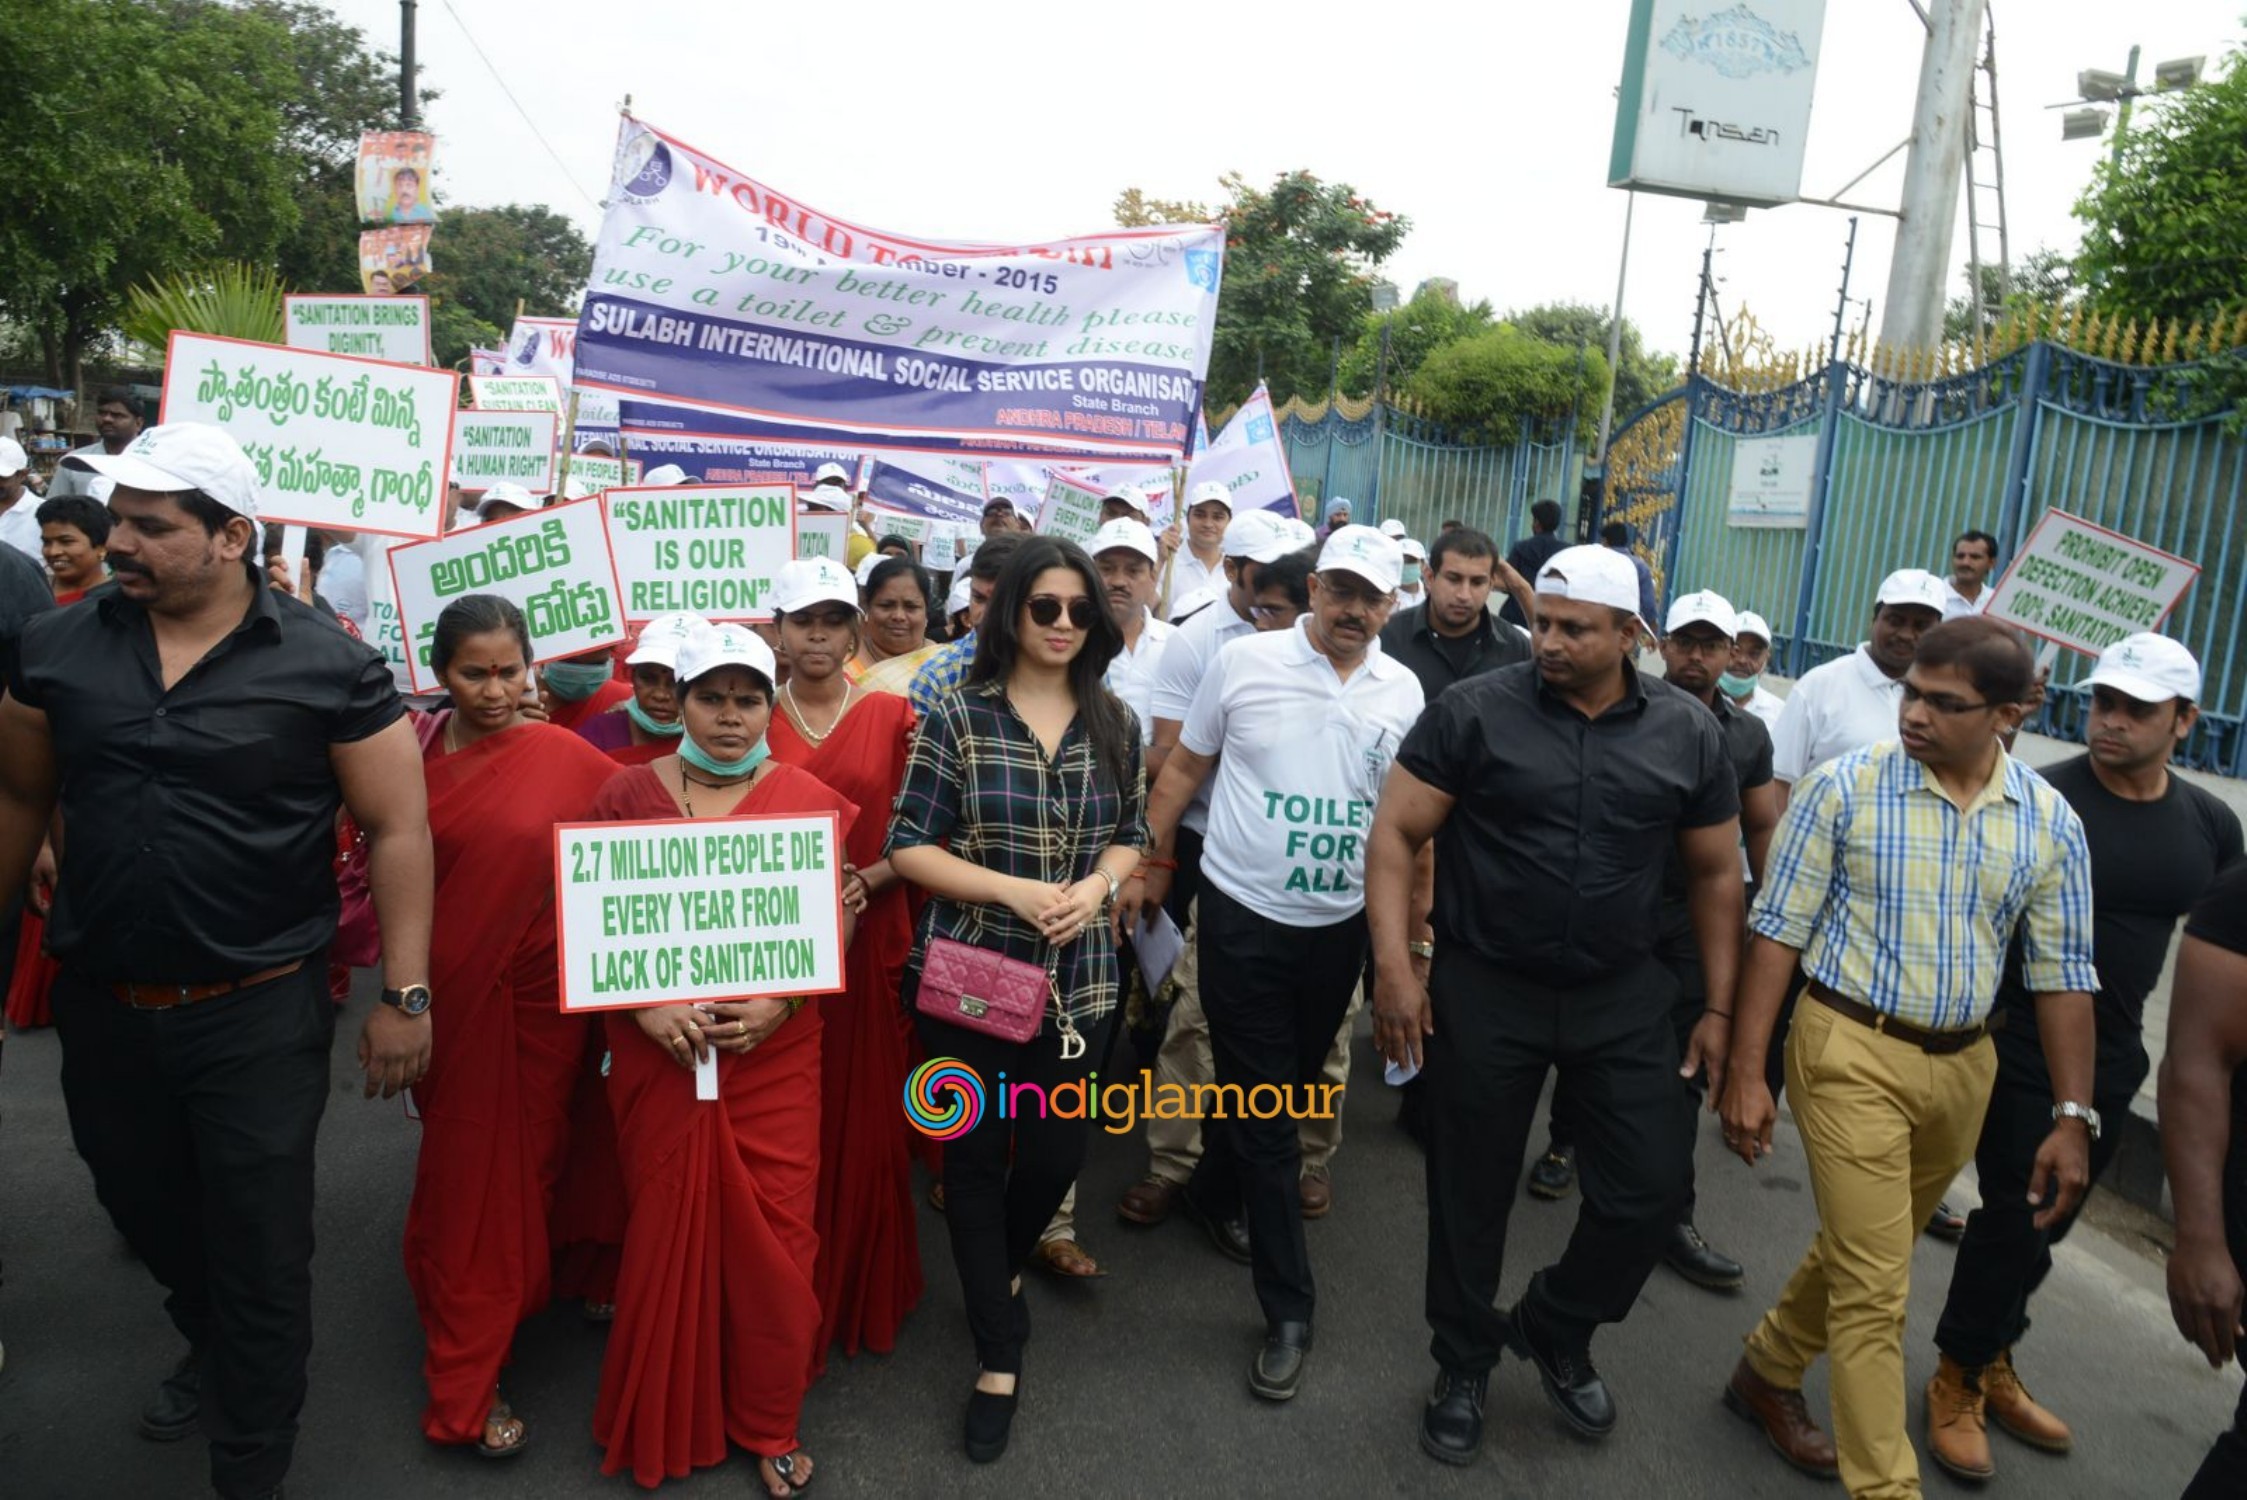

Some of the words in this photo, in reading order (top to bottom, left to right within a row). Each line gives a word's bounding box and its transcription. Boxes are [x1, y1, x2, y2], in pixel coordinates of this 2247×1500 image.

[692, 162, 855, 260] WORLD
[620, 225, 706, 259] For
[709, 250, 820, 286] your
[836, 269, 947, 308] better
[960, 290, 1072, 327] health
[1081, 307, 1198, 334] please
[995, 266, 1059, 295] 2015
[373, 304, 420, 326] BRINGS
[602, 266, 674, 295] use
[691, 285, 721, 307] a
[736, 293, 848, 328] toilet
[863, 313, 912, 337] &
[914, 323, 1049, 358] prevent
[1066, 336, 1194, 362] disease
[589, 303, 695, 347] SULABH
[699, 322, 888, 382] INTERNATIONAL
[893, 356, 972, 393] SOCIAL
[976, 368, 1074, 392] SERVICE
[313, 374, 370, 424] కంటే
[371, 386, 421, 448] మిన్న
[995, 408, 1062, 428] ANDHRA
[1064, 411, 1133, 438] PRADESH
[1072, 394, 1109, 411] State
[1111, 398, 1160, 417] Branch
[457, 455, 464, 475] A
[467, 455, 507, 476] HUMAN
[748, 457, 771, 469] State
[773, 459, 806, 470] Branch
[370, 460, 434, 515] గాంధీ
[613, 496, 786, 531] “SANITATION
[655, 540, 680, 570] IS
[688, 539, 746, 570] OUR
[2054, 529, 2130, 574] PROHIBIT
[2121, 556, 2169, 591] OPEN
[631, 578, 771, 611] RELIGION”
[2007, 588, 2046, 623] 100%
[2016, 554, 2102, 605] DEFECTION
[2093, 585, 2163, 627] ACHIEVE
[379, 624, 403, 642] FO
[380, 645, 406, 663] AL
[572, 841, 603, 883] 2.7
[609, 837, 698, 881] MILLION
[704, 832, 785, 876] PEOPLE
[790, 830, 825, 871] DIE
[1285, 830, 1358, 862] FOR
[1284, 866, 1350, 893] ALL
[602, 893, 673, 937] EVERY
[679, 889, 737, 932] YEAR
[742, 885, 800, 928] FROM
[591, 949, 650, 993] LACK
[655, 947, 683, 989] OF
[690, 938, 815, 987] SANITATION
